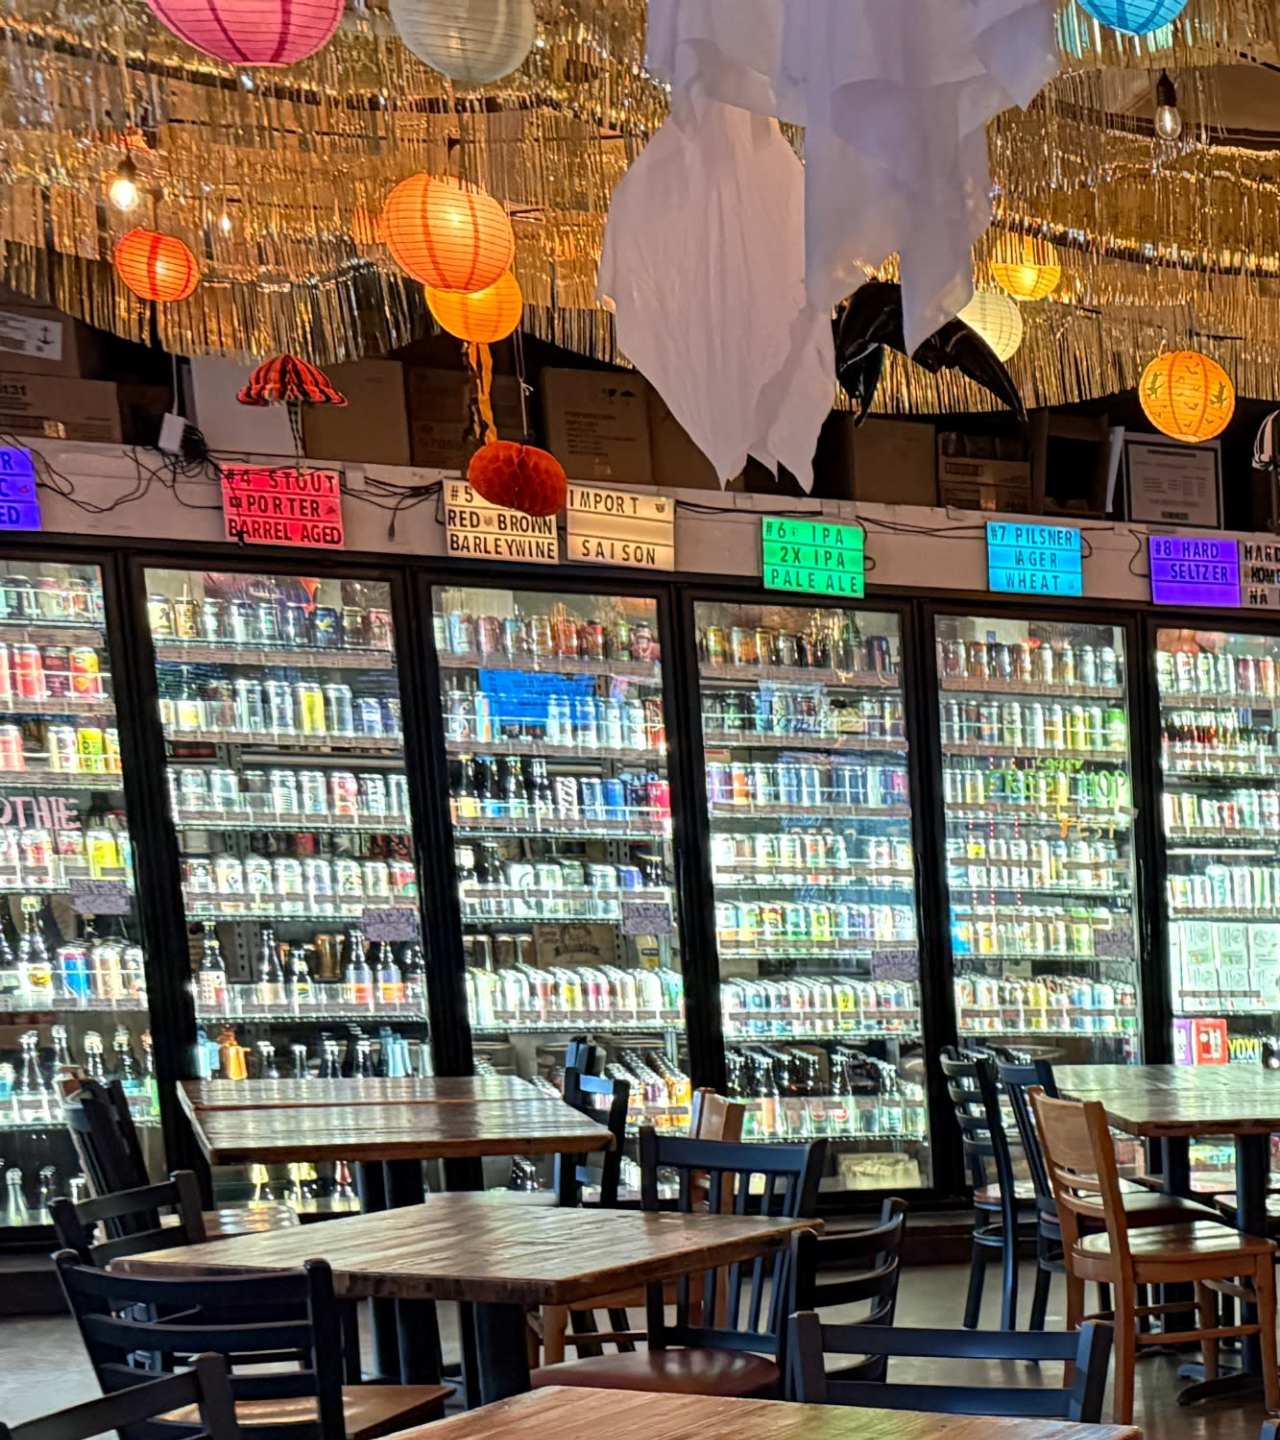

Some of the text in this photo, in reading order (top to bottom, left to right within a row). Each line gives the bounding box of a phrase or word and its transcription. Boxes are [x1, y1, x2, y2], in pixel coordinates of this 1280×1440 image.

[268, 470, 335, 494] STOUT
[246, 494, 321, 518] PORTER
[569, 489, 640, 515] IMPORT
[228, 518, 342, 545] BARREL AGED
[448, 509, 552, 536] RED BROWN
[811, 524, 844, 545] IPA
[450, 533, 555, 560] BARLEYWINE
[1014, 526, 1073, 547] PILSNER
[581, 539, 656, 566] SAISON
[779, 545, 845, 569] 2X IPA
[1182, 541, 1220, 560] HARD
[771, 568, 858, 594] PALE ALE
[1005, 571, 1060, 591] WHEAT
[1170, 562, 1229, 583] SELTZER
[1249, 589, 1269, 606] NA
